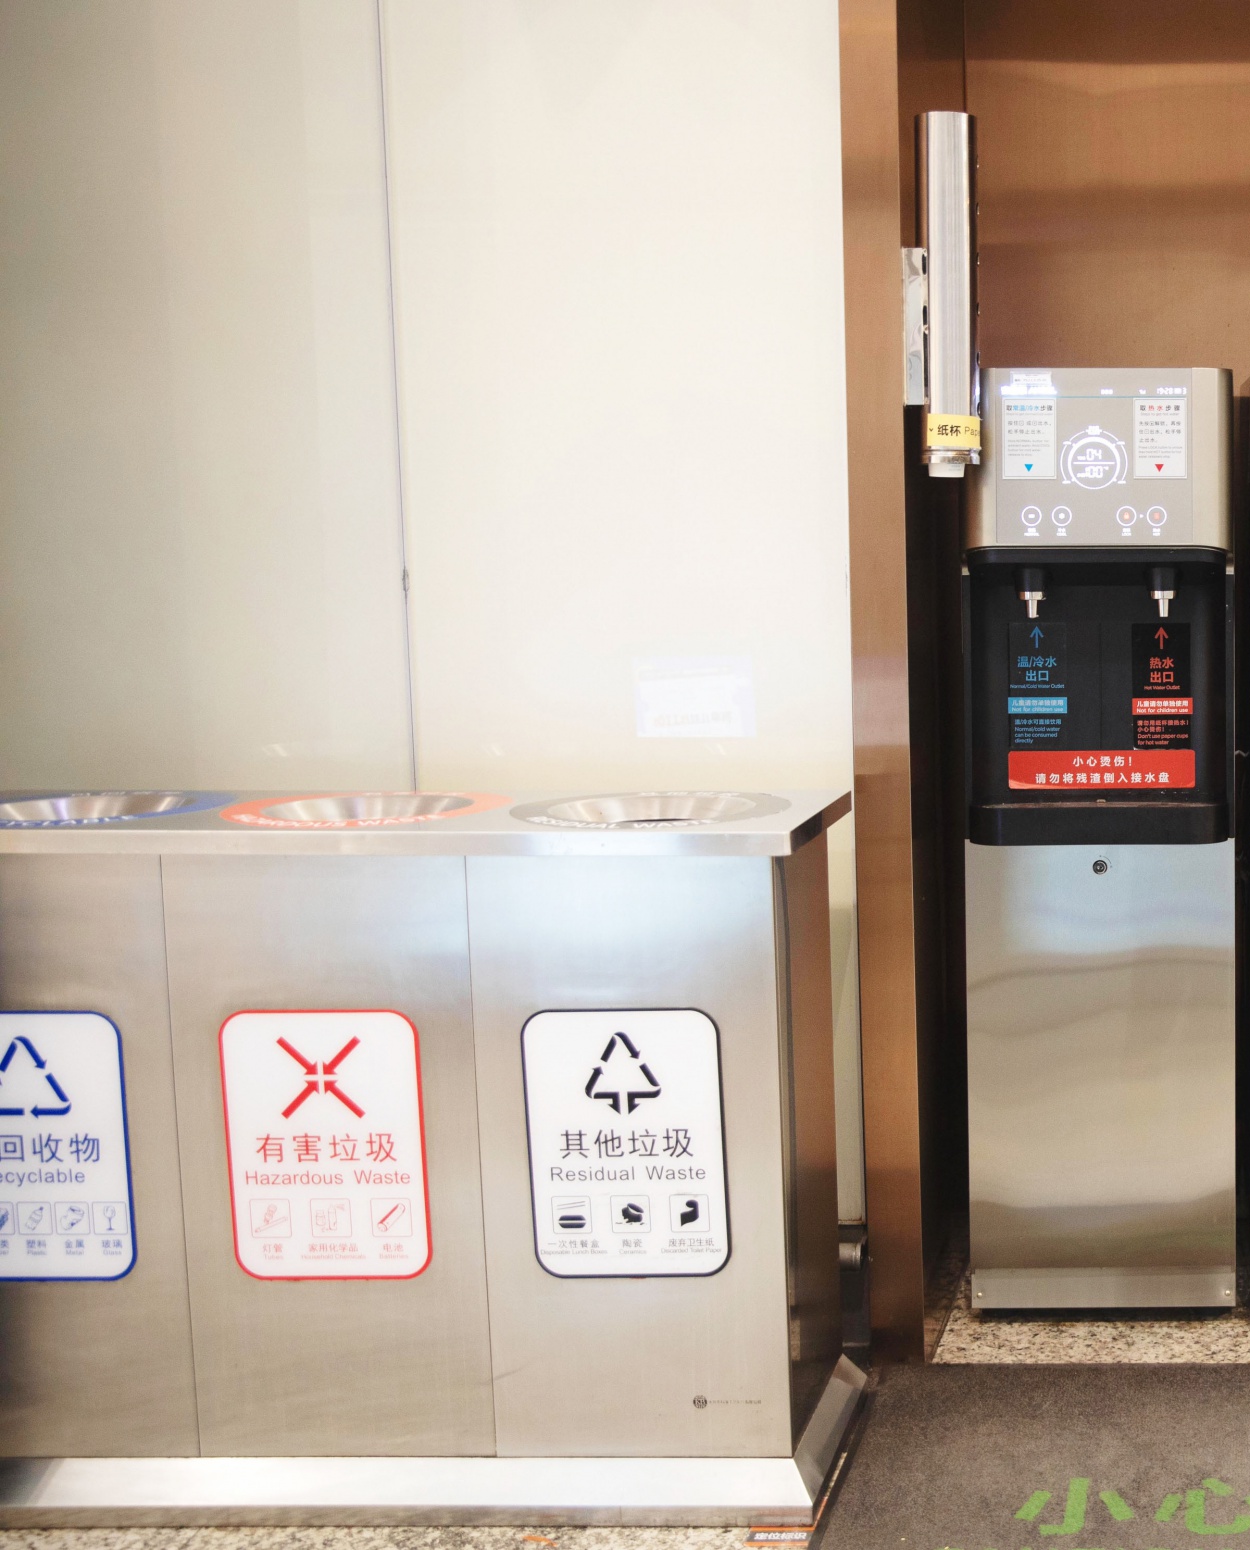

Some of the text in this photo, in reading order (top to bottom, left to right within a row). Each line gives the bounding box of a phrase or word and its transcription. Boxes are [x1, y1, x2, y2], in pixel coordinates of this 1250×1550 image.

[937, 424, 961, 436] 纸杯
[1017, 655, 1057, 668] 温/冷水
[1149, 657, 1174, 669] 热水
[1025, 669, 1049, 681] 出口
[1150, 671, 1174, 683] 出口
[1072, 755, 1133, 767] 小心烫伤！
[1035, 772, 1170, 784] 请勿将残渣倒入接水盘
[256, 1132, 399, 1163] 有害垃圾
[559, 1128, 694, 1159] 其他垃圾
[245, 1169, 411, 1186] Hazardous Waste
[551, 1165, 706, 1182] Residual Waste
[26, 1239, 46, 1248] 塑料
[65, 1239, 84, 1248] 金属
[102, 1239, 123, 1248] 玻璃
[263, 1243, 283, 1253] 灯管
[308, 1243, 358, 1253] 家用化学品
[382, 1243, 404, 1253] 电池
[548, 1239, 600, 1249] 一次性餐盒
[622, 1238, 643, 1248] 陶瓷
[668, 1238, 715, 1248] 废弃卫生纸
[705, 1247, 722, 1255] Paper
[754, 1532, 807, 1540] 定位标识
